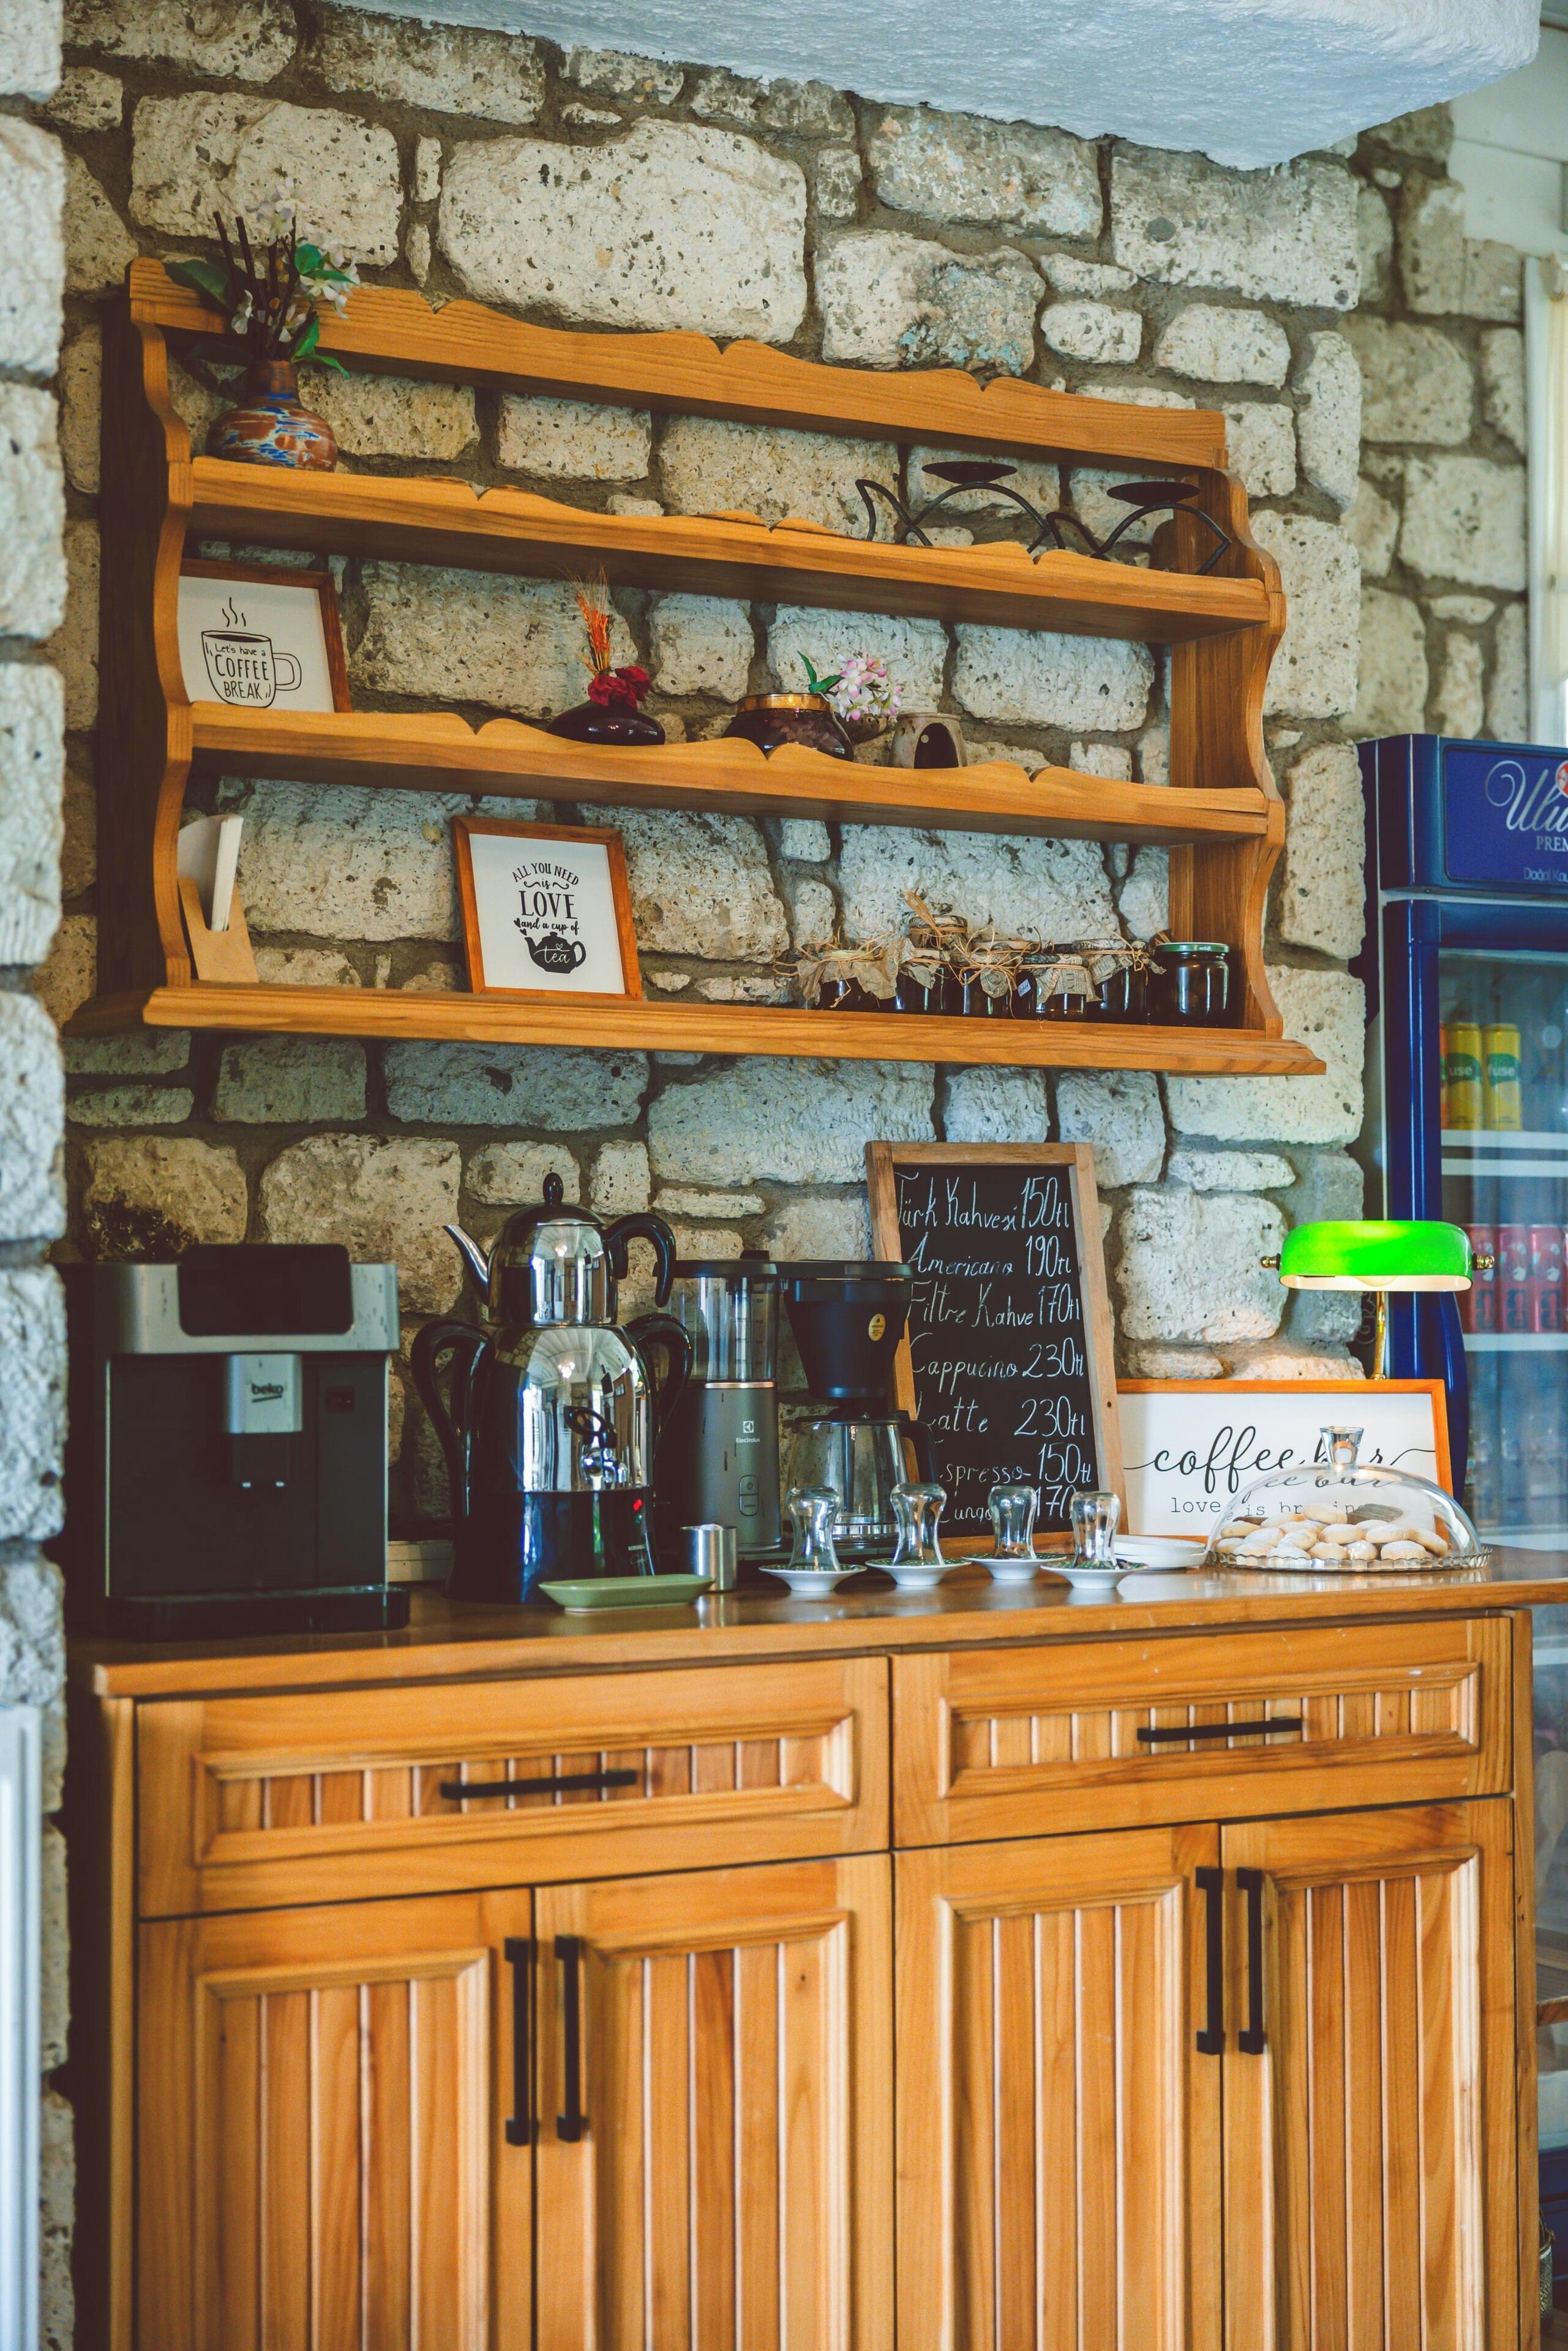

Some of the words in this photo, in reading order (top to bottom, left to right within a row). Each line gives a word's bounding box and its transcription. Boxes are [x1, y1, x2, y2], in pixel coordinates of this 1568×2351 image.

[215, 643, 236, 653] Let's
[239, 646, 257, 656] have
[214, 654, 269, 680] COFFEE
[223, 681, 263, 700] BREAK
[512, 865, 531, 883] ALL
[531, 862, 552, 874] YOU
[553, 865, 579, 885] NEED
[541, 878, 551, 890] is
[518, 890, 578, 920] LOVE
[521, 917, 541, 930] and
[551, 923, 569, 935] cup
[570, 920, 580, 936] of
[535, 945, 571, 964] tea
[894, 1172, 938, 1228] Türk
[945, 1177, 1018, 1231] Kahvesi
[908, 1231, 1013, 1277] Americano
[907, 1280, 967, 1323] Filtre
[971, 1283, 1034, 1327] Kahve
[252, 1382, 284, 1395] beko
[1125, 1425, 1296, 1494] coffee
[937, 1448, 1032, 1496] spresso
[1171, 1498, 1221, 1513] love
[1245, 1504, 1265, 1517] is
